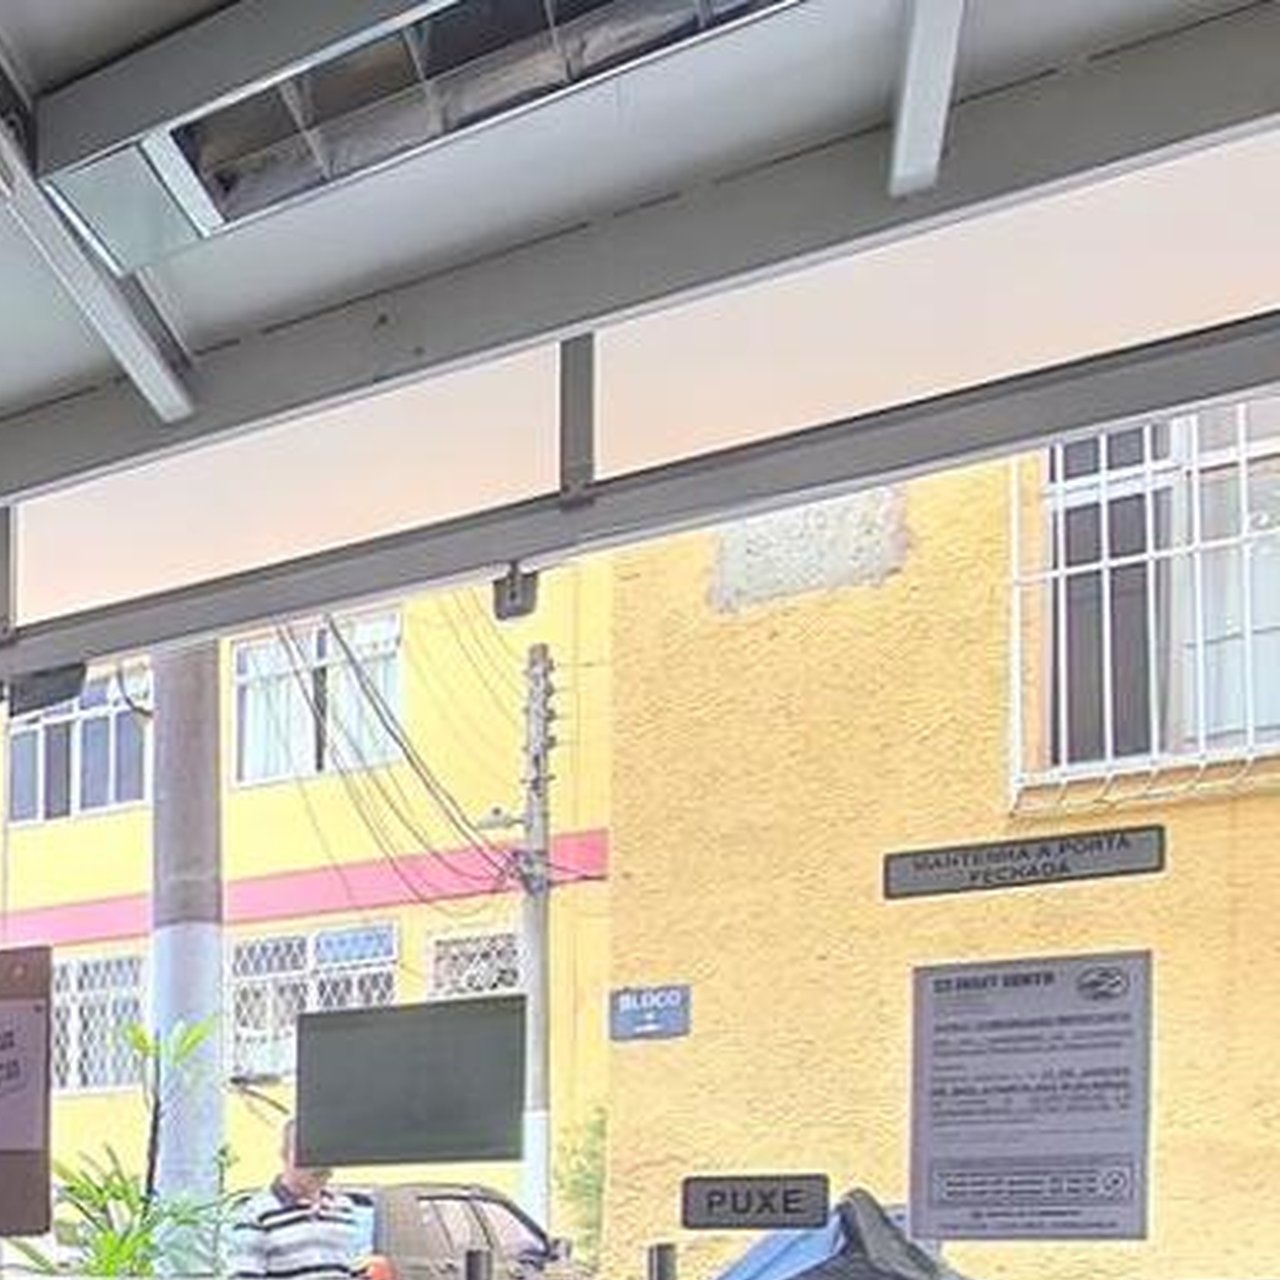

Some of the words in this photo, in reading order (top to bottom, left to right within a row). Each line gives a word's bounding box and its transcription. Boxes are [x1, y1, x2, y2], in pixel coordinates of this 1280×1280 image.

[912, 848, 1030, 873] MANTENHA
[1038, 844, 1052, 861] A
[1061, 833, 1132, 857] PORTA
[968, 862, 1071, 886] FECHADA
[619, 990, 681, 1012] BLOCO
[705, 1188, 805, 1215] PUXE
